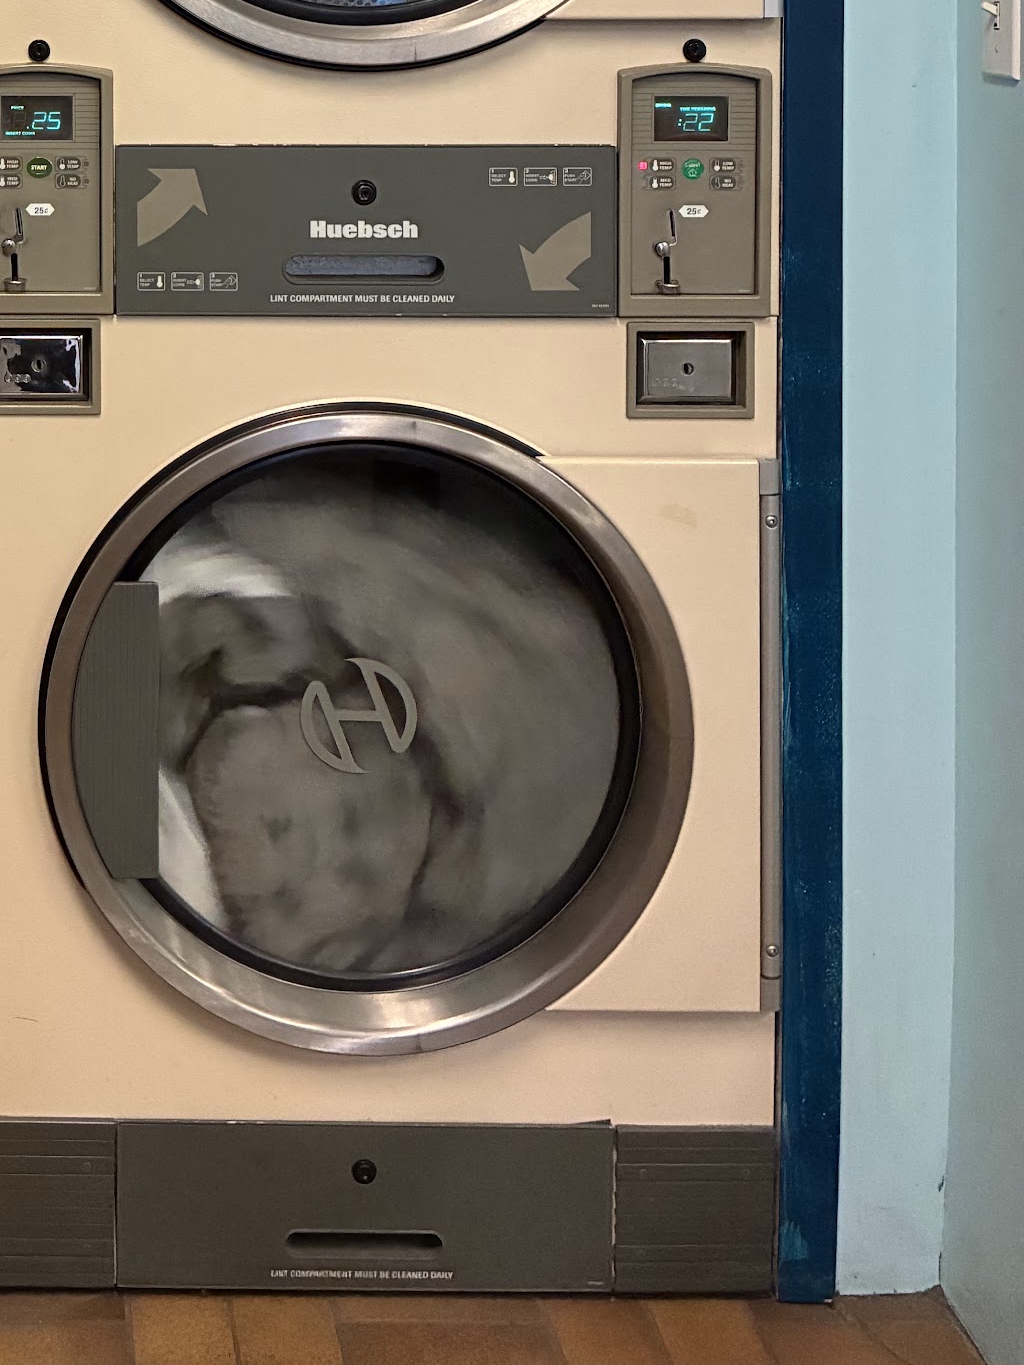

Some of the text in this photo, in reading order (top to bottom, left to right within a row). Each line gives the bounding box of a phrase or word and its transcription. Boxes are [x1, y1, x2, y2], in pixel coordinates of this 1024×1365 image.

[310, 221, 418, 238] Huebsch
[380, 295, 390, 303] BE
[392, 295, 430, 303] CLEANED
[432, 295, 455, 303] DAILY
